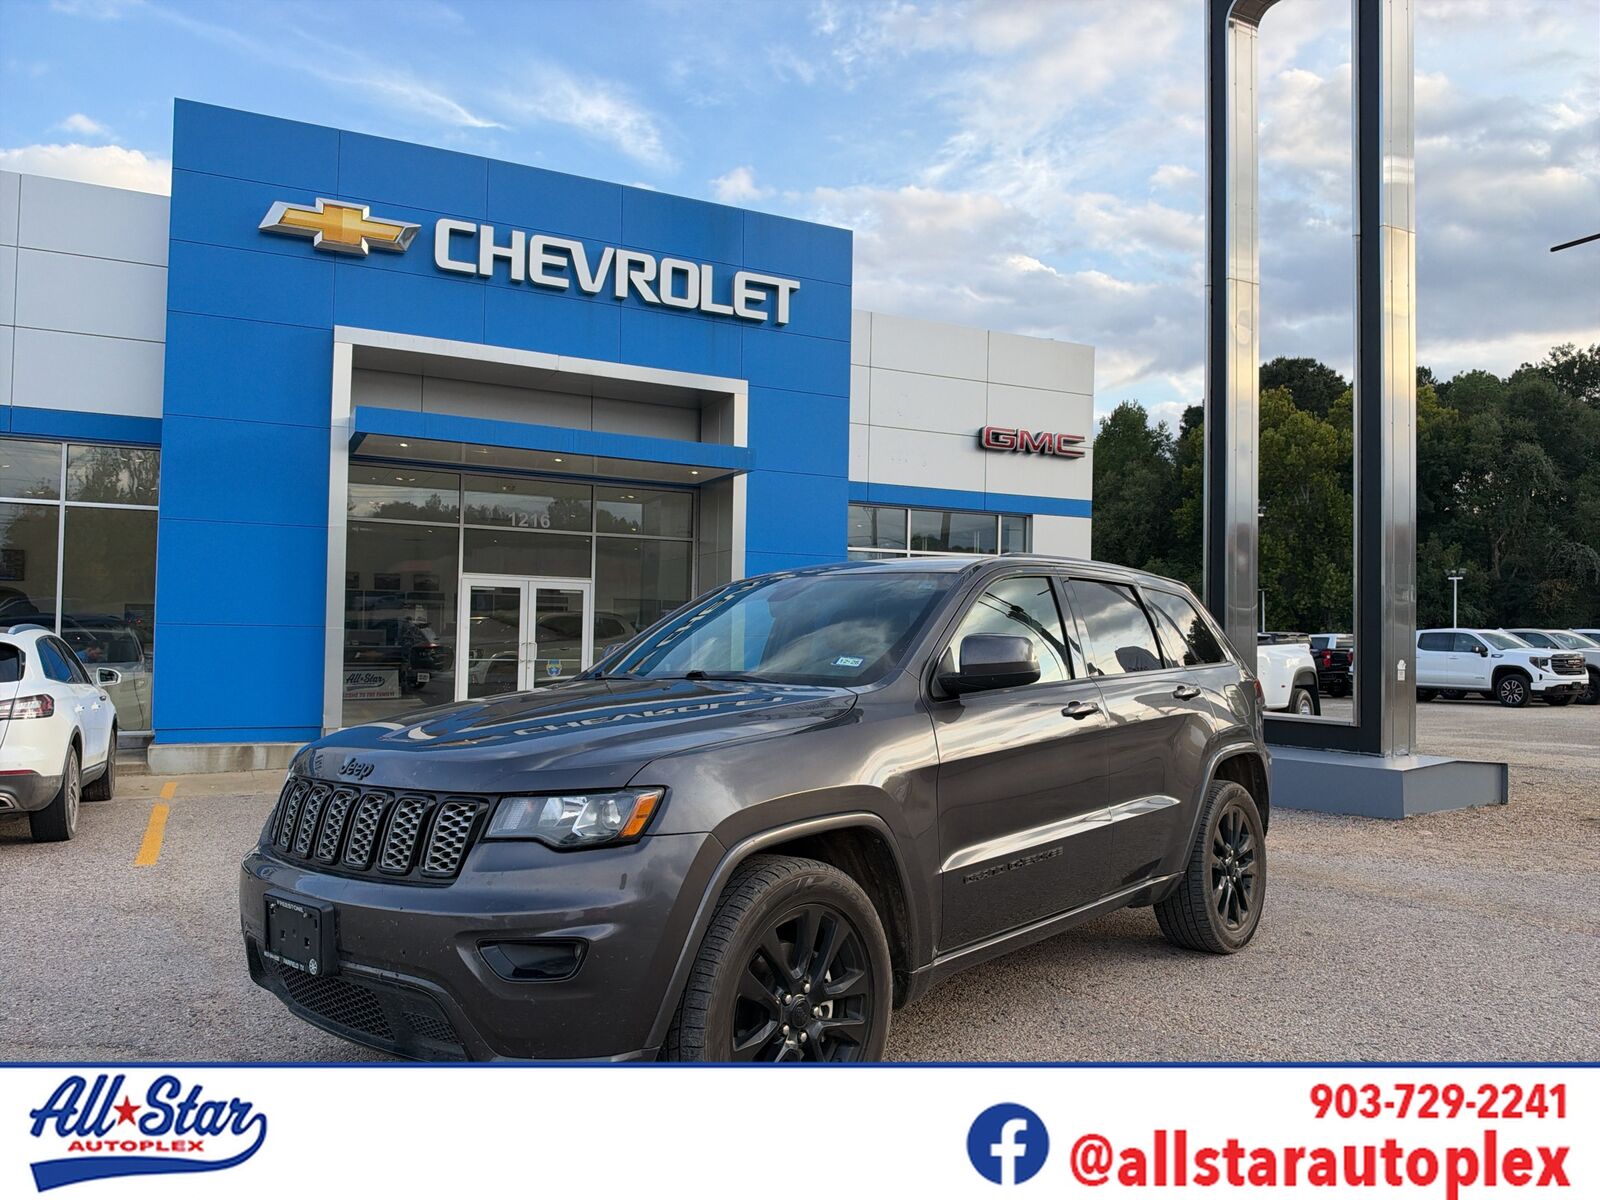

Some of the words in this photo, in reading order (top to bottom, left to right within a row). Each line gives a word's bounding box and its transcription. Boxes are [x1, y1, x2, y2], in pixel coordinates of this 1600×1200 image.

[434, 218, 801, 326] CHEVROLET
[980, 425, 1086, 460] GMC
[508, 511, 551, 529] 1216
[339, 757, 375, 781] Jeep
